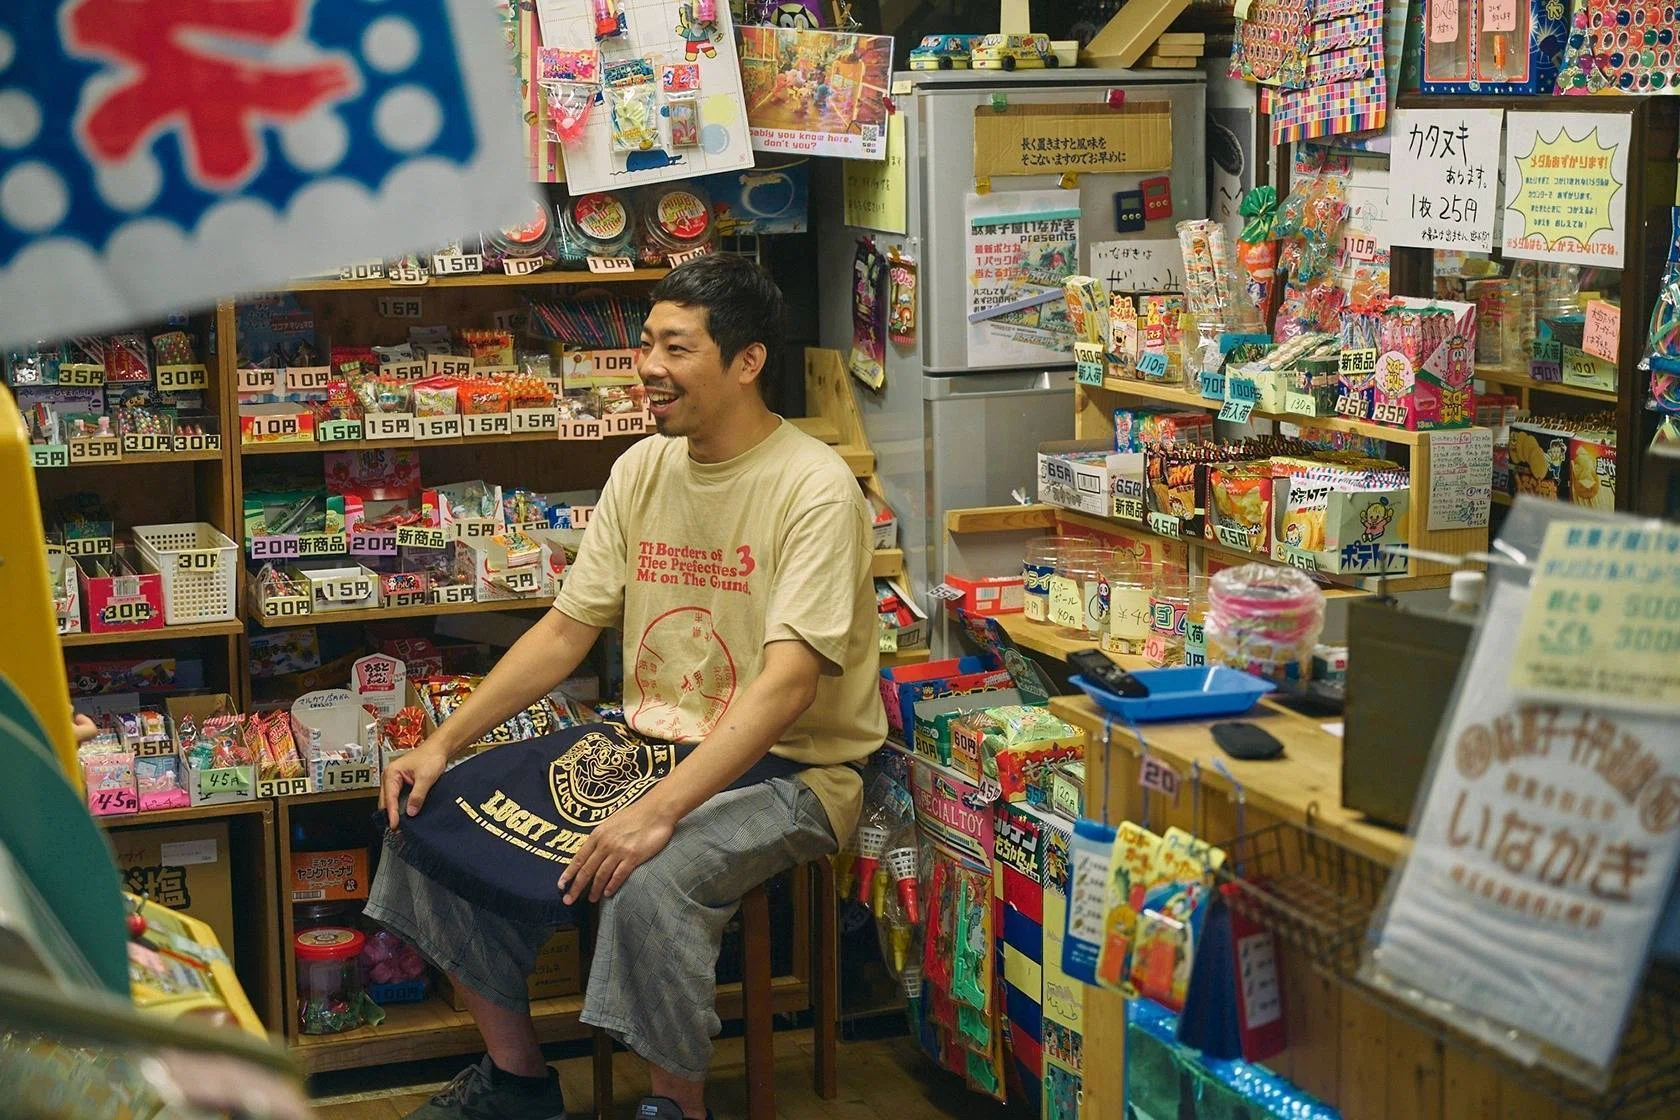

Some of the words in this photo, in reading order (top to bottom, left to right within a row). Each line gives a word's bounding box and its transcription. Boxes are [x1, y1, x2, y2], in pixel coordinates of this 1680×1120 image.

[764, 139, 789, 148] don't
[793, 141, 816, 150] you?
[778, 132, 795, 140] you
[799, 132, 824, 141] know
[1021, 136, 1106, 152] 長く置きますと風味を
[1408, 120, 1469, 166] カタヌキ
[1021, 152, 1126, 166] そこないますのでお早めに
[1446, 166, 1488, 189] あります。
[1412, 194, 1433, 219] 1枚
[1439, 194, 1478, 224] 25円
[1020, 232, 1076, 244] presents
[1344, 238, 1374, 254] 110円
[340, 264, 383, 278] 30円
[438, 258, 478, 271] 15円
[590, 258, 630, 270] 10円
[381, 302, 420, 315] 15円
[594, 356, 632, 370] 10円
[1138, 356, 1164, 373] 110円
[1342, 352, 1374, 372] 新商品
[60, 369, 104, 384] 35円
[160, 372, 204, 386] 30円
[289, 373, 329, 386] 10円
[1078, 364, 1102, 384] 新入荷
[1220, 402, 1250, 422] 新入荷
[1338, 396, 1369, 417] 35円
[1374, 404, 1406, 422] 35円
[255, 420, 296, 434] 10円
[368, 420, 410, 434] 15円
[418, 420, 458, 436] 15円
[469, 416, 508, 432] 15円
[517, 414, 556, 428] 15円
[606, 416, 644, 432] 10円
[320, 426, 360, 440] 15円
[561, 423, 600, 438] 10円
[72, 444, 118, 458] 35円
[126, 436, 170, 450] 30円
[174, 436, 220, 450] 30円
[1048, 463, 1072, 482] 65円
[1116, 478, 1142, 498] 65円
[1290, 486, 1334, 504] ポテトフラ
[1115, 498, 1142, 519] 新商品
[456, 524, 494, 536] 15円
[1154, 518, 1178, 537] 45円
[298, 536, 345, 553] 新商品
[352, 537, 396, 551] 20円
[398, 528, 444, 547] 新商品
[1220, 528, 1248, 548] 45円
[66, 539, 112, 554] 30円
[254, 540, 298, 555] 20円
[656, 543, 707, 560] Borders
[710, 548, 723, 562] of
[736, 544, 756, 577] 3
[1288, 556, 1317, 572] 45円
[506, 574, 534, 587] 5円
[660, 572, 678, 585] on
[682, 572, 706, 587] The
[328, 582, 369, 597] 15円
[266, 600, 310, 616] 30円
[384, 593, 426, 607] 15円
[105, 602, 150, 619] 30円
[1058, 608, 1076, 625] 40円
[132, 740, 174, 756] 35円
[954, 735, 976, 754] 60円
[210, 772, 240, 787] 45円
[328, 770, 370, 785] 15円
[260, 780, 306, 796] 30円
[556, 772, 588, 818] LUCKY
[1056, 784, 1076, 808] 120円
[98, 791, 137, 809] 45円
[918, 789, 958, 824] SPECIAL
[958, 806, 985, 837] TOY
[480, 789, 558, 842] LUCKY
[545, 828, 591, 855] PIE
